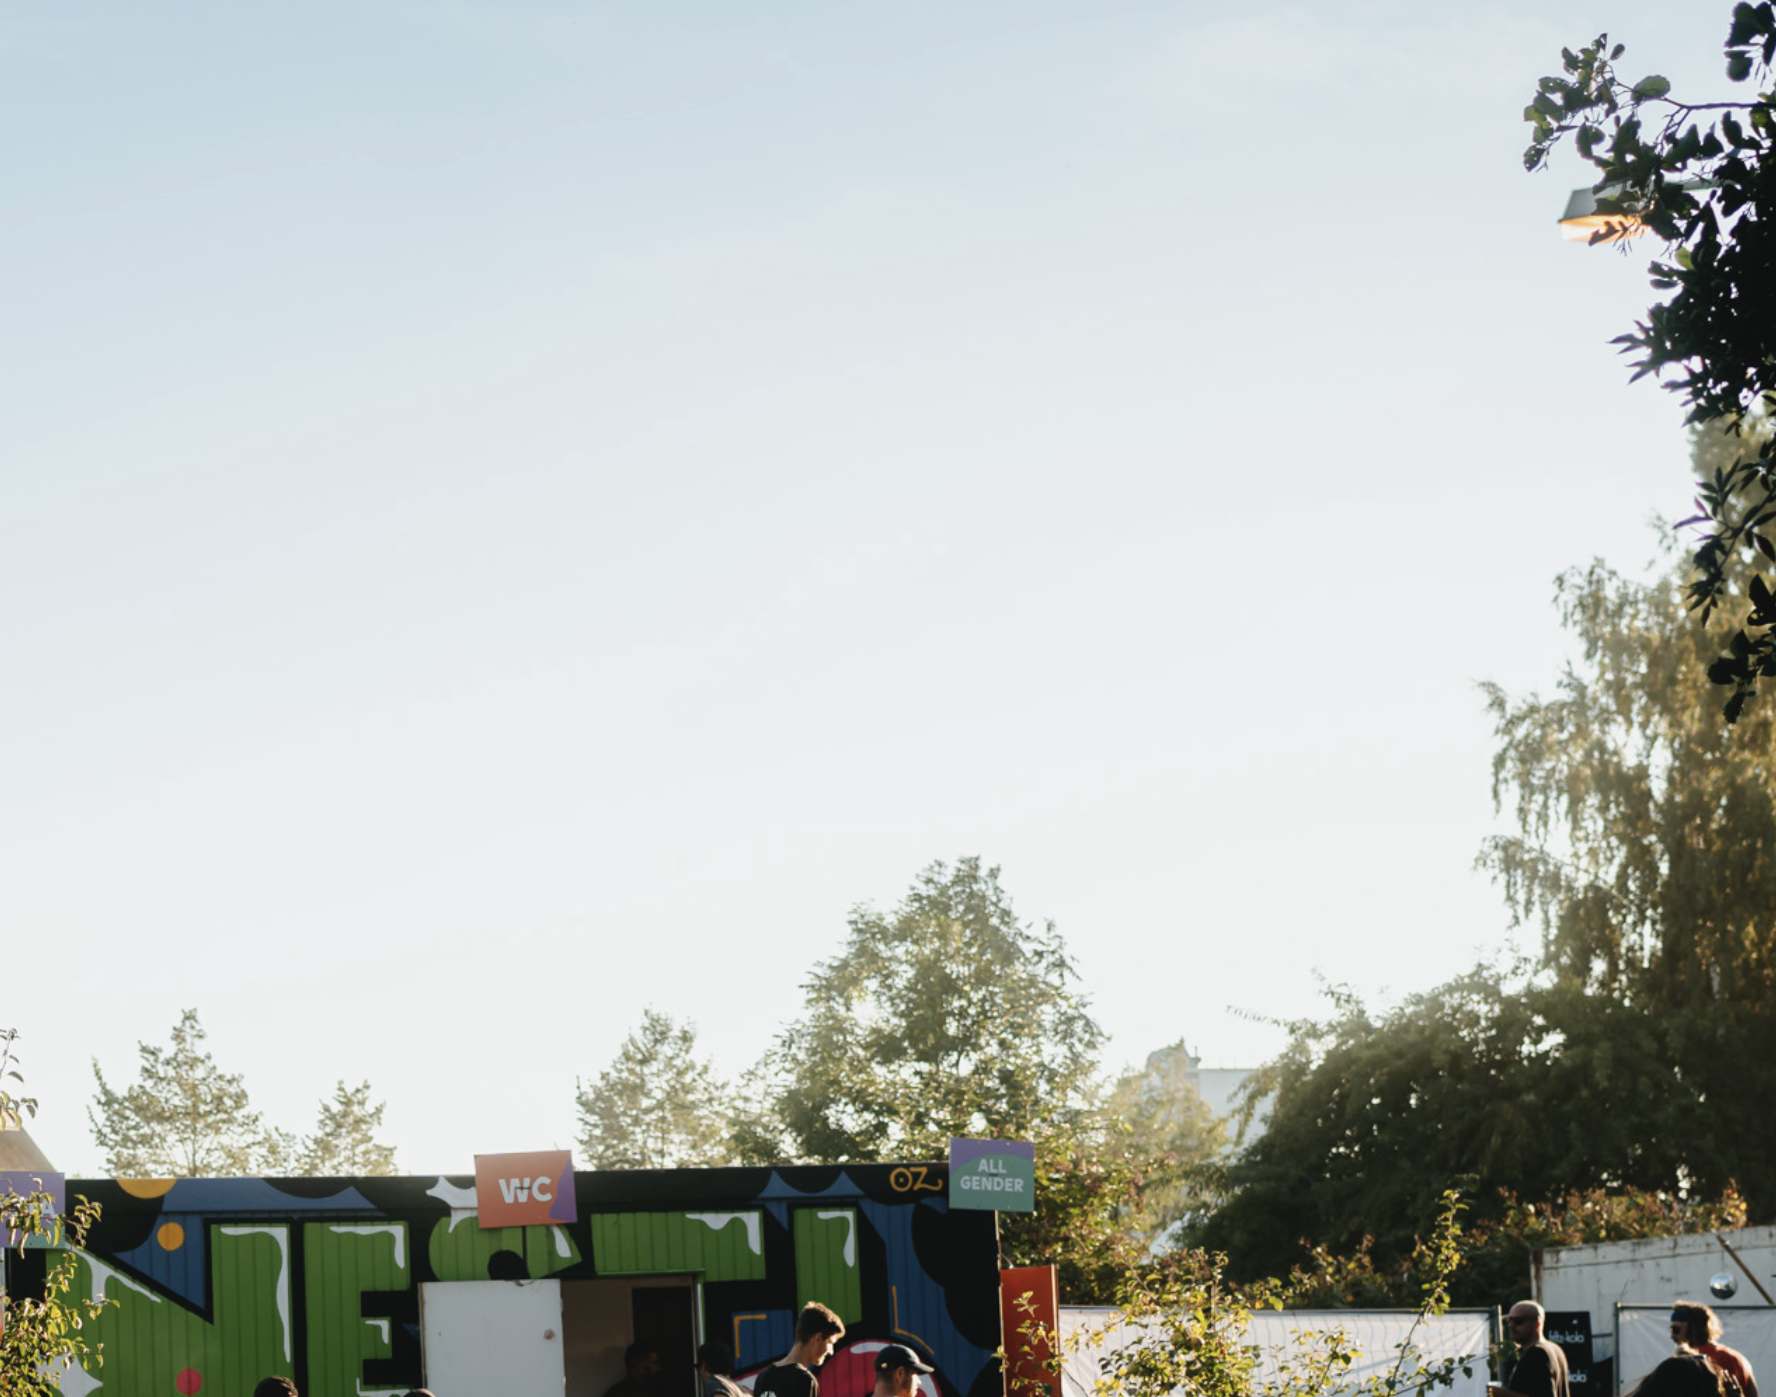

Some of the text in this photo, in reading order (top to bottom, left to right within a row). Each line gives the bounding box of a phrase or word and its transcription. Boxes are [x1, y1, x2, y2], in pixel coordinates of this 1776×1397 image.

[977, 1158, 1007, 1174] ALL
[889, 1166, 943, 1192] OZ
[960, 1175, 1024, 1192] GENDER
[498, 1176, 553, 1204] WC
